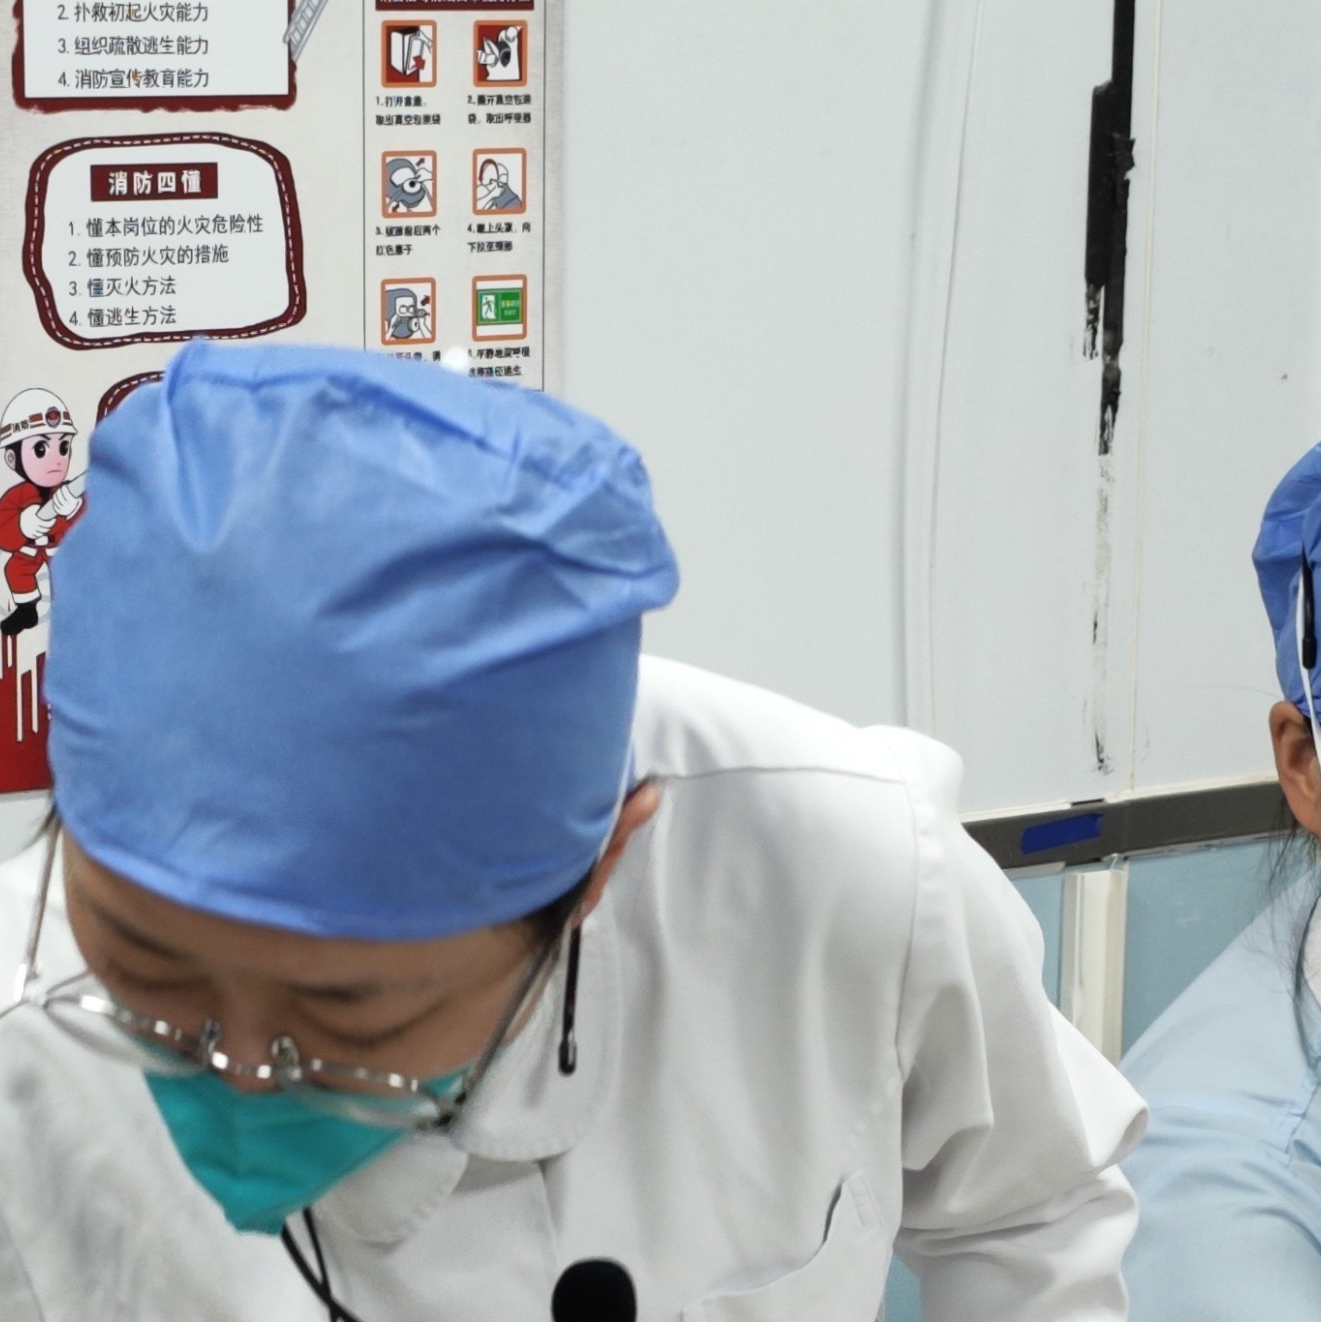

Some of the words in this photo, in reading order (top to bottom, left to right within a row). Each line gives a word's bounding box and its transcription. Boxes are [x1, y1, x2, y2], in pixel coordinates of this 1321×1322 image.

[57, 4, 70, 22] 2.
[74, 2, 209, 23] 扑救初起火灾能力
[57, 38, 70, 54] 3.
[74, 35, 209, 56] 组织疏散逃生能力
[57, 71, 70, 88] 4.
[74, 68, 209, 89] 消防宣传教育能力
[108, 169, 201, 196] 消防四懂
[68, 220, 80, 236] 1.
[86, 213, 264, 238] 懂本岗位的火灾危险性
[68, 250, 81, 267] 2.
[86, 244, 229, 268] 懂预防火灾的措施
[68, 281, 81, 297] 3.
[87, 275, 177, 297] 懂灭火方法
[68, 311, 81, 327] 4.
[87, 305, 177, 327] 懂逃生方法
